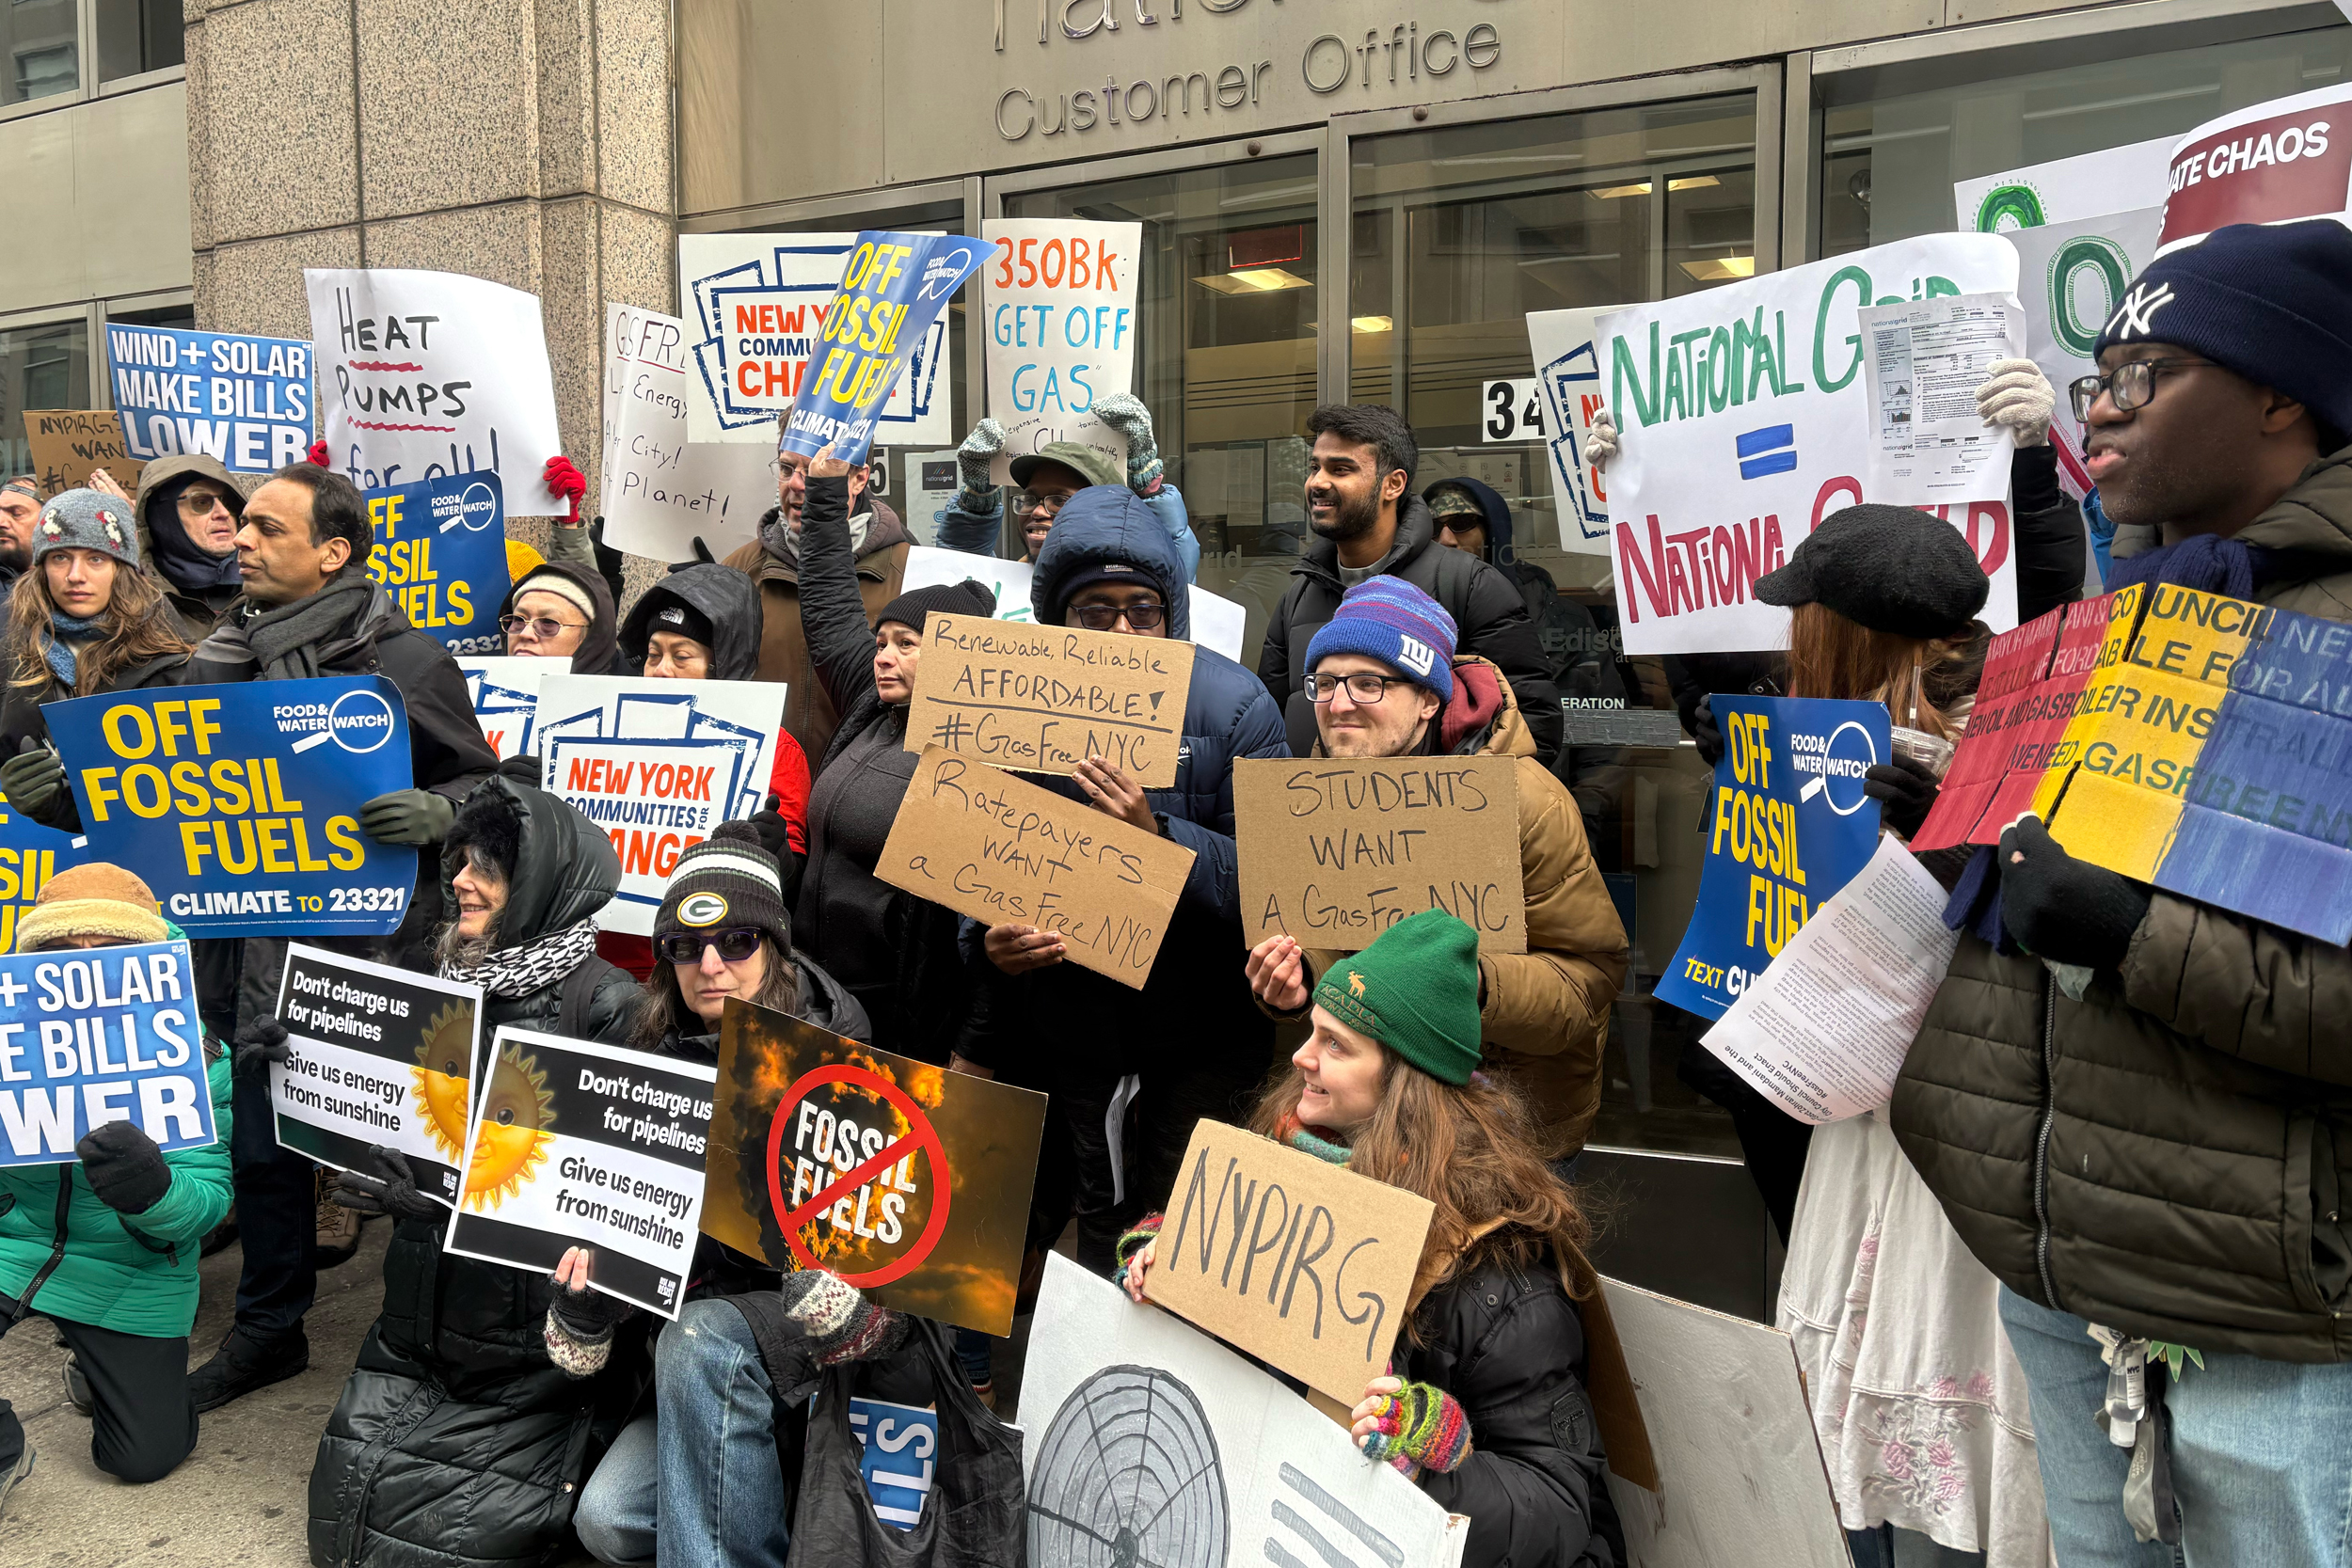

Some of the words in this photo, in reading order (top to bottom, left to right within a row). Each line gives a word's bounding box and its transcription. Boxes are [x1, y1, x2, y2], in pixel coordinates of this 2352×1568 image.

[995, 58, 1270, 141] Customer
[1302, 20, 1501, 93] Office
[2207, 121, 2331, 180] CHAOS
[844, 241, 914, 295] OFF
[335, 286, 440, 354] HEAT
[736, 304, 805, 334] NEW
[1065, 306, 1130, 351] OFF
[111, 330, 177, 368] WIND
[181, 341, 207, 365] +
[211, 340, 306, 379] SOLAR
[117, 368, 201, 414] MAKE
[211, 376, 307, 422] BILLS
[336, 365, 472, 419] PUMPS
[72, 439, 127, 461] WAN
[122, 411, 308, 469] LOWER
[790, 408, 850, 444] CLIMAT
[346, 443, 403, 491] for
[631, 434, 682, 469] City!
[368, 494, 405, 540] FF
[433, 505, 459, 517] WATER
[463, 499, 492, 513] WATCH
[623, 471, 730, 524] Planet!
[365, 537, 437, 585] SSIL
[447, 633, 502, 656] 2332
[1064, 633, 1168, 674] Reliable
[1985, 626, 2026, 663] MAYOR
[952, 663, 1167, 722] AFFORDABLE!
[2201, 651, 2293, 702] FOR
[277, 718, 327, 733] WATER
[333, 713, 388, 729] WATCH
[1561, 697, 1625, 709] ERATION
[1963, 713, 1989, 739] NEW
[1986, 706, 2004, 735] OIL
[2003, 699, 2028, 729] AND
[2026, 692, 2059, 721] GAS
[2058, 685, 2141, 720] BOILER
[101, 699, 221, 760] OFF
[1727, 711, 1772, 789] OFF
[2030, 739, 2080, 768] NEED
[82, 757, 303, 822] FOSSIL
[566, 757, 635, 795] NEW
[639, 761, 716, 802] YORK
[1792, 754, 1823, 774] WATER
[1826, 759, 1872, 779] WATCH
[1285, 768, 1488, 817] STUDENTS
[697, 807, 709, 831] FOR
[931, 757, 1144, 886] Ratepayers
[1712, 785, 1806, 887] FOSSIL
[179, 816, 366, 876] FUELS
[600, 827, 704, 879] ANG
[909, 855, 935, 879] a
[983, 834, 1073, 884] WANT
[1309, 828, 1427, 872] WANT
[169, 890, 293, 916] CLIMATE
[296, 895, 324, 913] TO
[328, 887, 405, 911] 23321
[1261, 893, 1294, 937] A
[1746, 874, 1828, 958] FUEL
[34, 952, 183, 1013] SOLAR
[293, 970, 331, 998] Don't
[331, 981, 388, 1016] charge
[389, 999, 410, 1019] us
[1684, 958, 1724, 990] TEXT
[287, 999, 310, 1022] for
[310, 1006, 382, 1042] pipelines
[1320, 985, 1375, 1025] ACADIA
[39, 1007, 191, 1080] BILLS
[1723, 1044, 1738, 1059] the
[1737, 1055, 1754, 1071] and
[1752, 1052, 1775, 1073] Enact
[283, 1051, 319, 1078] Give
[321, 1065, 341, 1085] us
[343, 1070, 405, 1107] energy
[578, 1069, 630, 1100] Don't
[631, 1080, 691, 1118] charge
[692, 1100, 713, 1121] us
[1751, 1068, 1786, 1098] Mamdani
[1773, 1069, 1800, 1093] Should
[1781, 1059, 1828, 1100] #GasFreeNYC
[1798, 1088, 1821, 1111] Council
[0, 1074, 206, 1158] WER
[283, 1079, 322, 1110] from
[325, 1095, 402, 1132] sunshine
[1784, 1094, 1805, 1114] Zohran
[1820, 1104, 1833, 1117] City
[603, 1106, 632, 1133] for
[631, 1114, 707, 1155] pipelines
[794, 1099, 917, 1195] FOSSIL
[559, 1157, 608, 1187] Give
[611, 1173, 631, 1195] us
[633, 1179, 693, 1220] energy
[790, 1155, 907, 1244] FUELS
[555, 1189, 609, 1224] from
[609, 1208, 684, 1250] sunshine
[1169, 1147, 1385, 1363] NYPIRG
[2126, 1366, 2140, 1375] NYC
